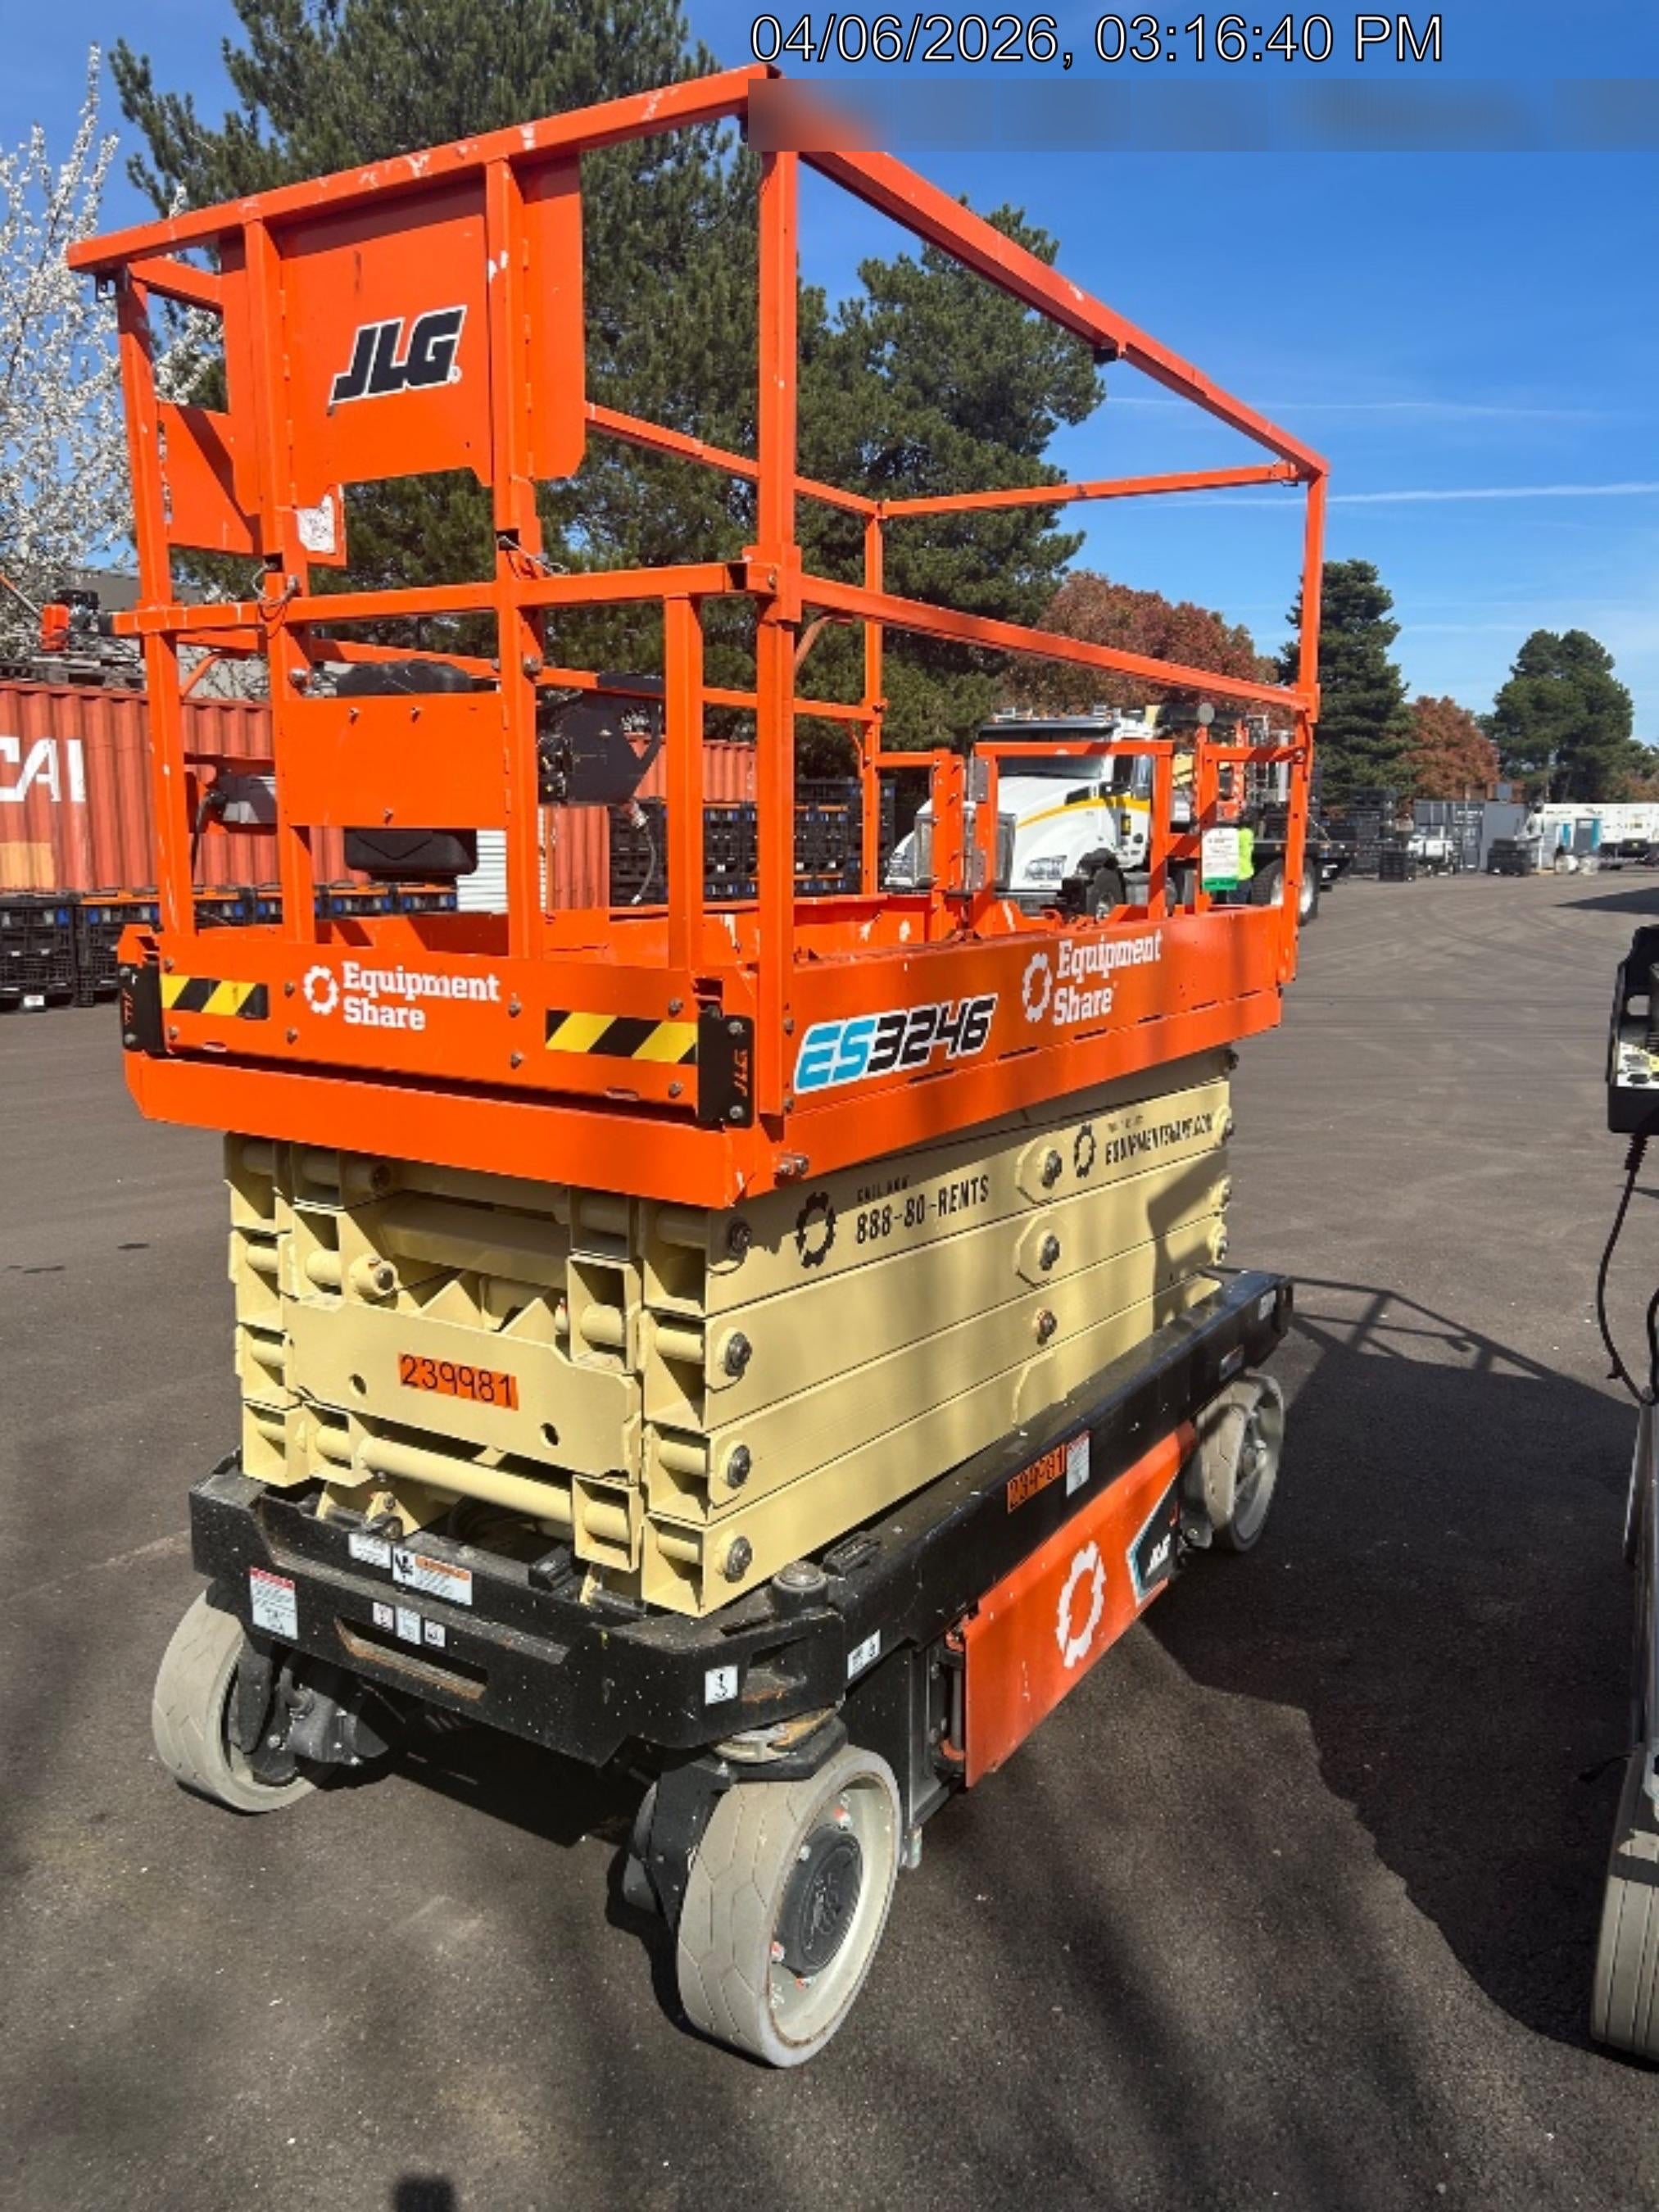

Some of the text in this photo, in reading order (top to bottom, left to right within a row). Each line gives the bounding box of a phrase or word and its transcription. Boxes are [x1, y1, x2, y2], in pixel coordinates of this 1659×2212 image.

[329, 304, 468, 406] JLG
[342, 960, 501, 1003] Equipment
[1056, 928, 1163, 984] Equipment
[342, 995, 427, 1031] Share
[1053, 985, 1114, 1026] Share
[793, 993, 999, 1095] ES3246
[856, 1174, 990, 1244] 888-80-RENTS
[401, 1353, 512, 1407] 239981
